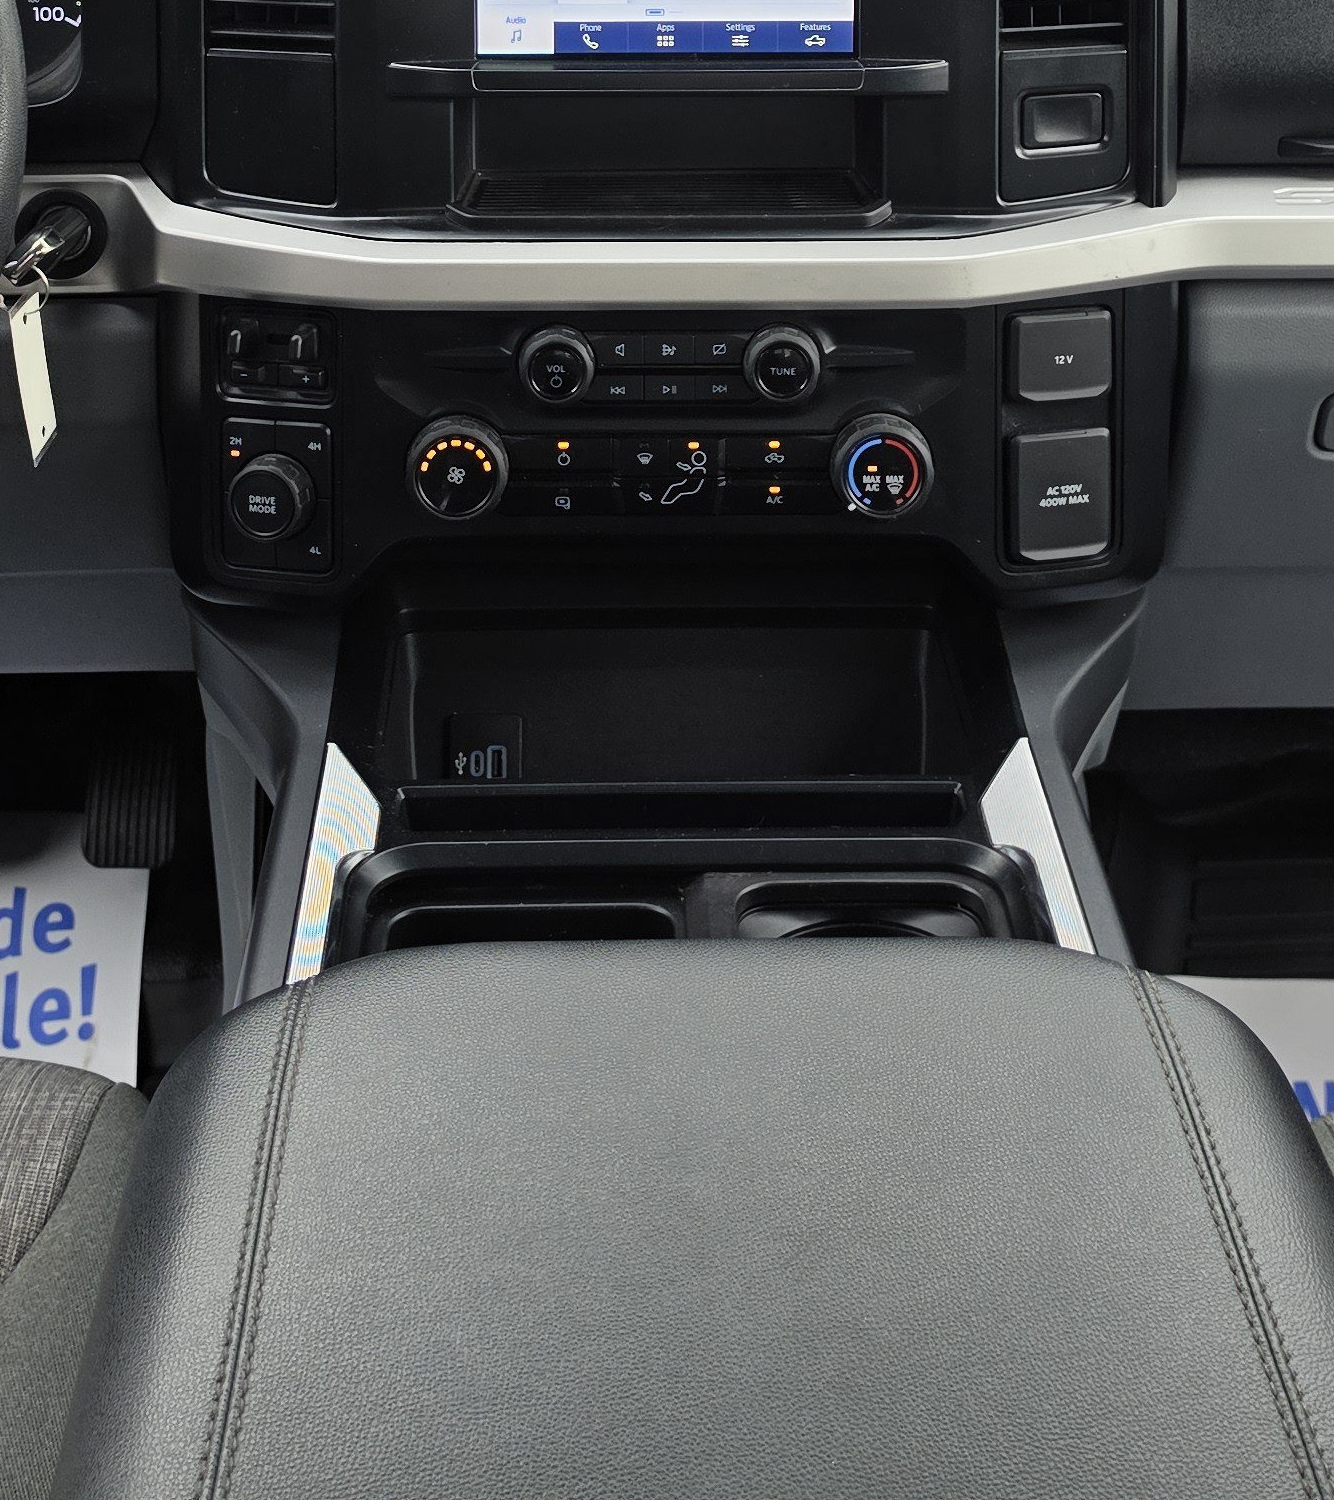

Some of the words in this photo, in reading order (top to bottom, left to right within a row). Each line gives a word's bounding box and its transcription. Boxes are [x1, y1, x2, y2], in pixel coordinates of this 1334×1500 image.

[32, 6, 65, 22] 100
[506, 16, 527, 24] Audio
[579, 23, 602, 32] Phone
[656, 23, 675, 33] Apps
[726, 23, 756, 33] Settings
[799, 23, 831, 32] Features
[546, 364, 566, 373] VOL
[769, 367, 797, 376] TUNE
[229, 436, 242, 446] 2H
[307, 441, 322, 451] 4H
[862, 475, 881, 484] MAX
[885, 475, 904, 484] MAX
[1047, 486, 1060, 496] AC
[1060, 483, 1082, 495] 120V
[248, 494, 276, 505] DRIVE
[766, 496, 783, 504] A/C
[1039, 497, 1067, 507] 400W
[1069, 494, 1089, 504] MAX
[248, 504, 277, 515] MODE
[309, 546, 321, 555] 4L
